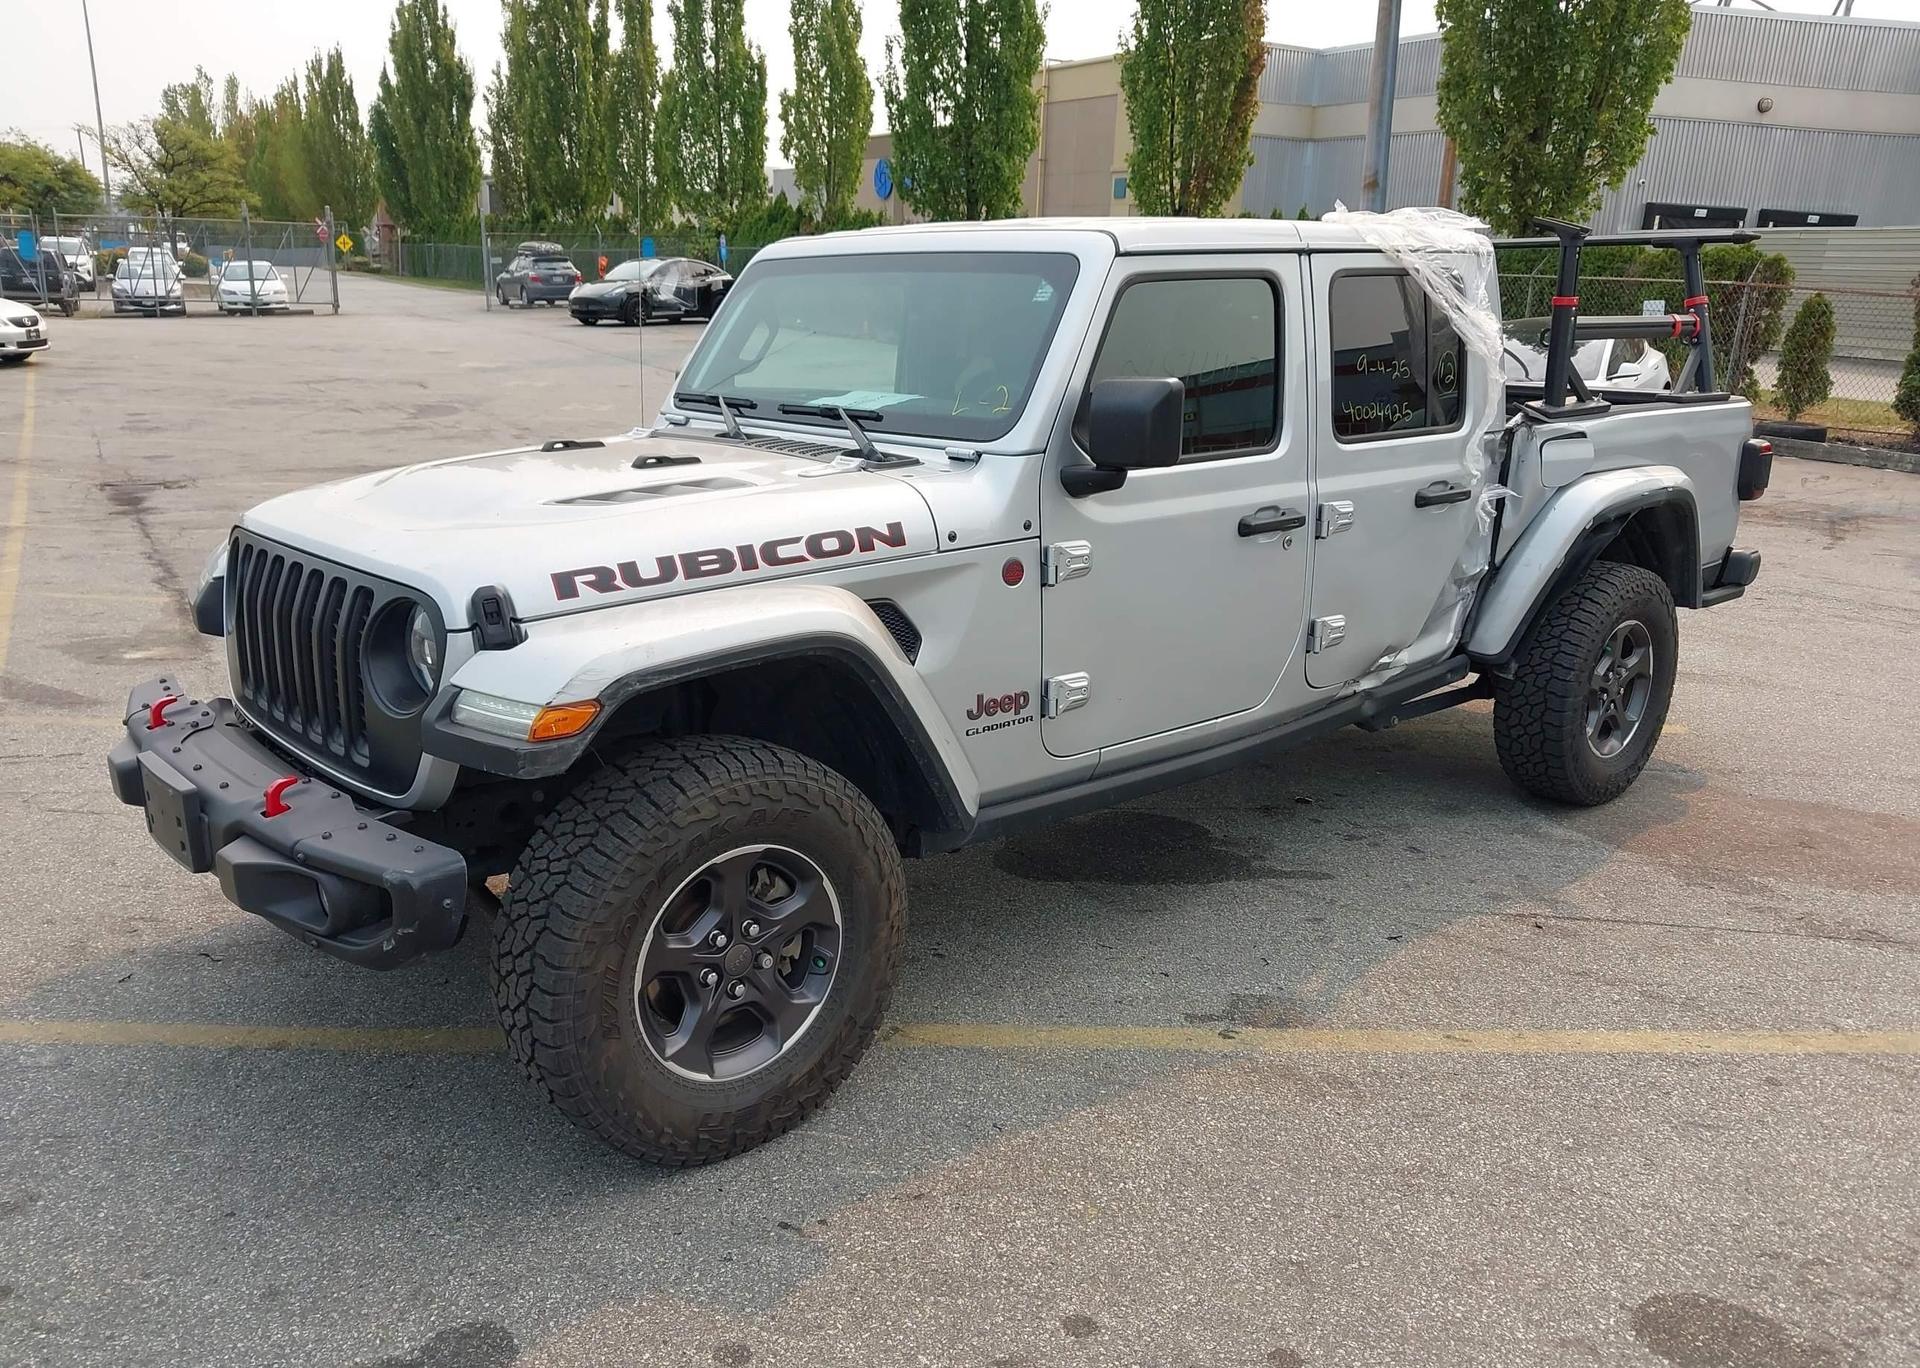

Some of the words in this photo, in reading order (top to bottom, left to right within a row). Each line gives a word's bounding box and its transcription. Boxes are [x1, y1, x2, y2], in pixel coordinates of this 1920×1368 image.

[1356, 353, 1411, 380] 9-4-25
[550, 521, 907, 601] RUBICON
[966, 690, 1030, 720] Jeep
[965, 715, 1034, 737] GLADIATOR
